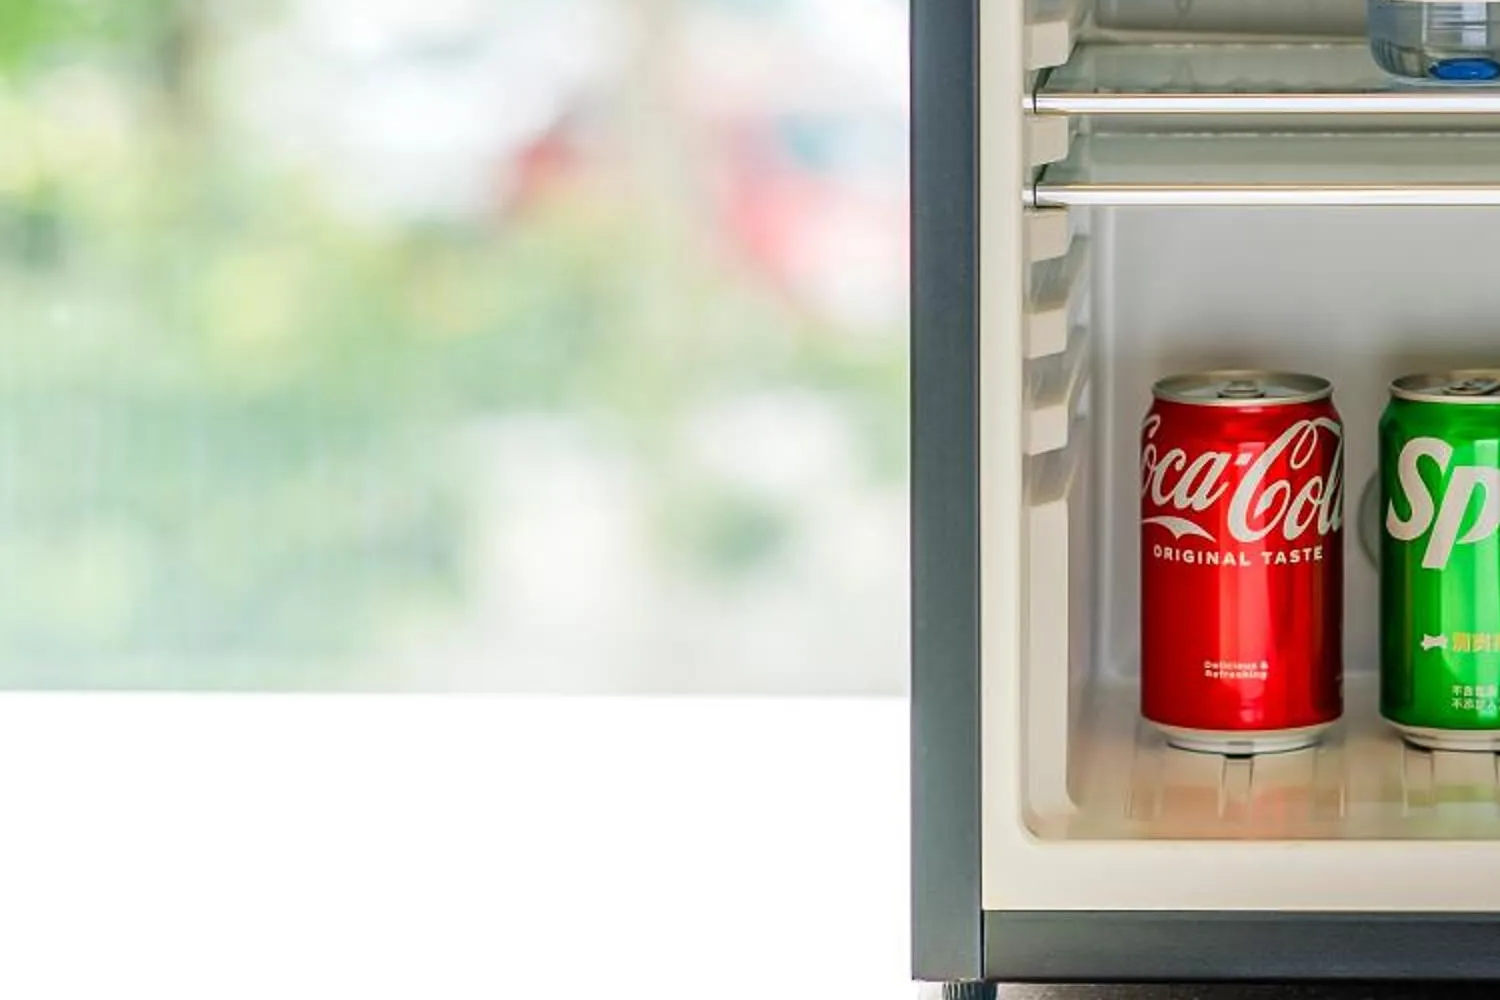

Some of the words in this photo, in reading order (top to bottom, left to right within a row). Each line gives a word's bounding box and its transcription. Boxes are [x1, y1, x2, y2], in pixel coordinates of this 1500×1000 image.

[1153, 543, 1252, 567] ORIGINAL
[1260, 544, 1324, 565] TASTE
[1203, 660, 1257, 670] Delicious
[1203, 670, 1269, 681] Refreshing
